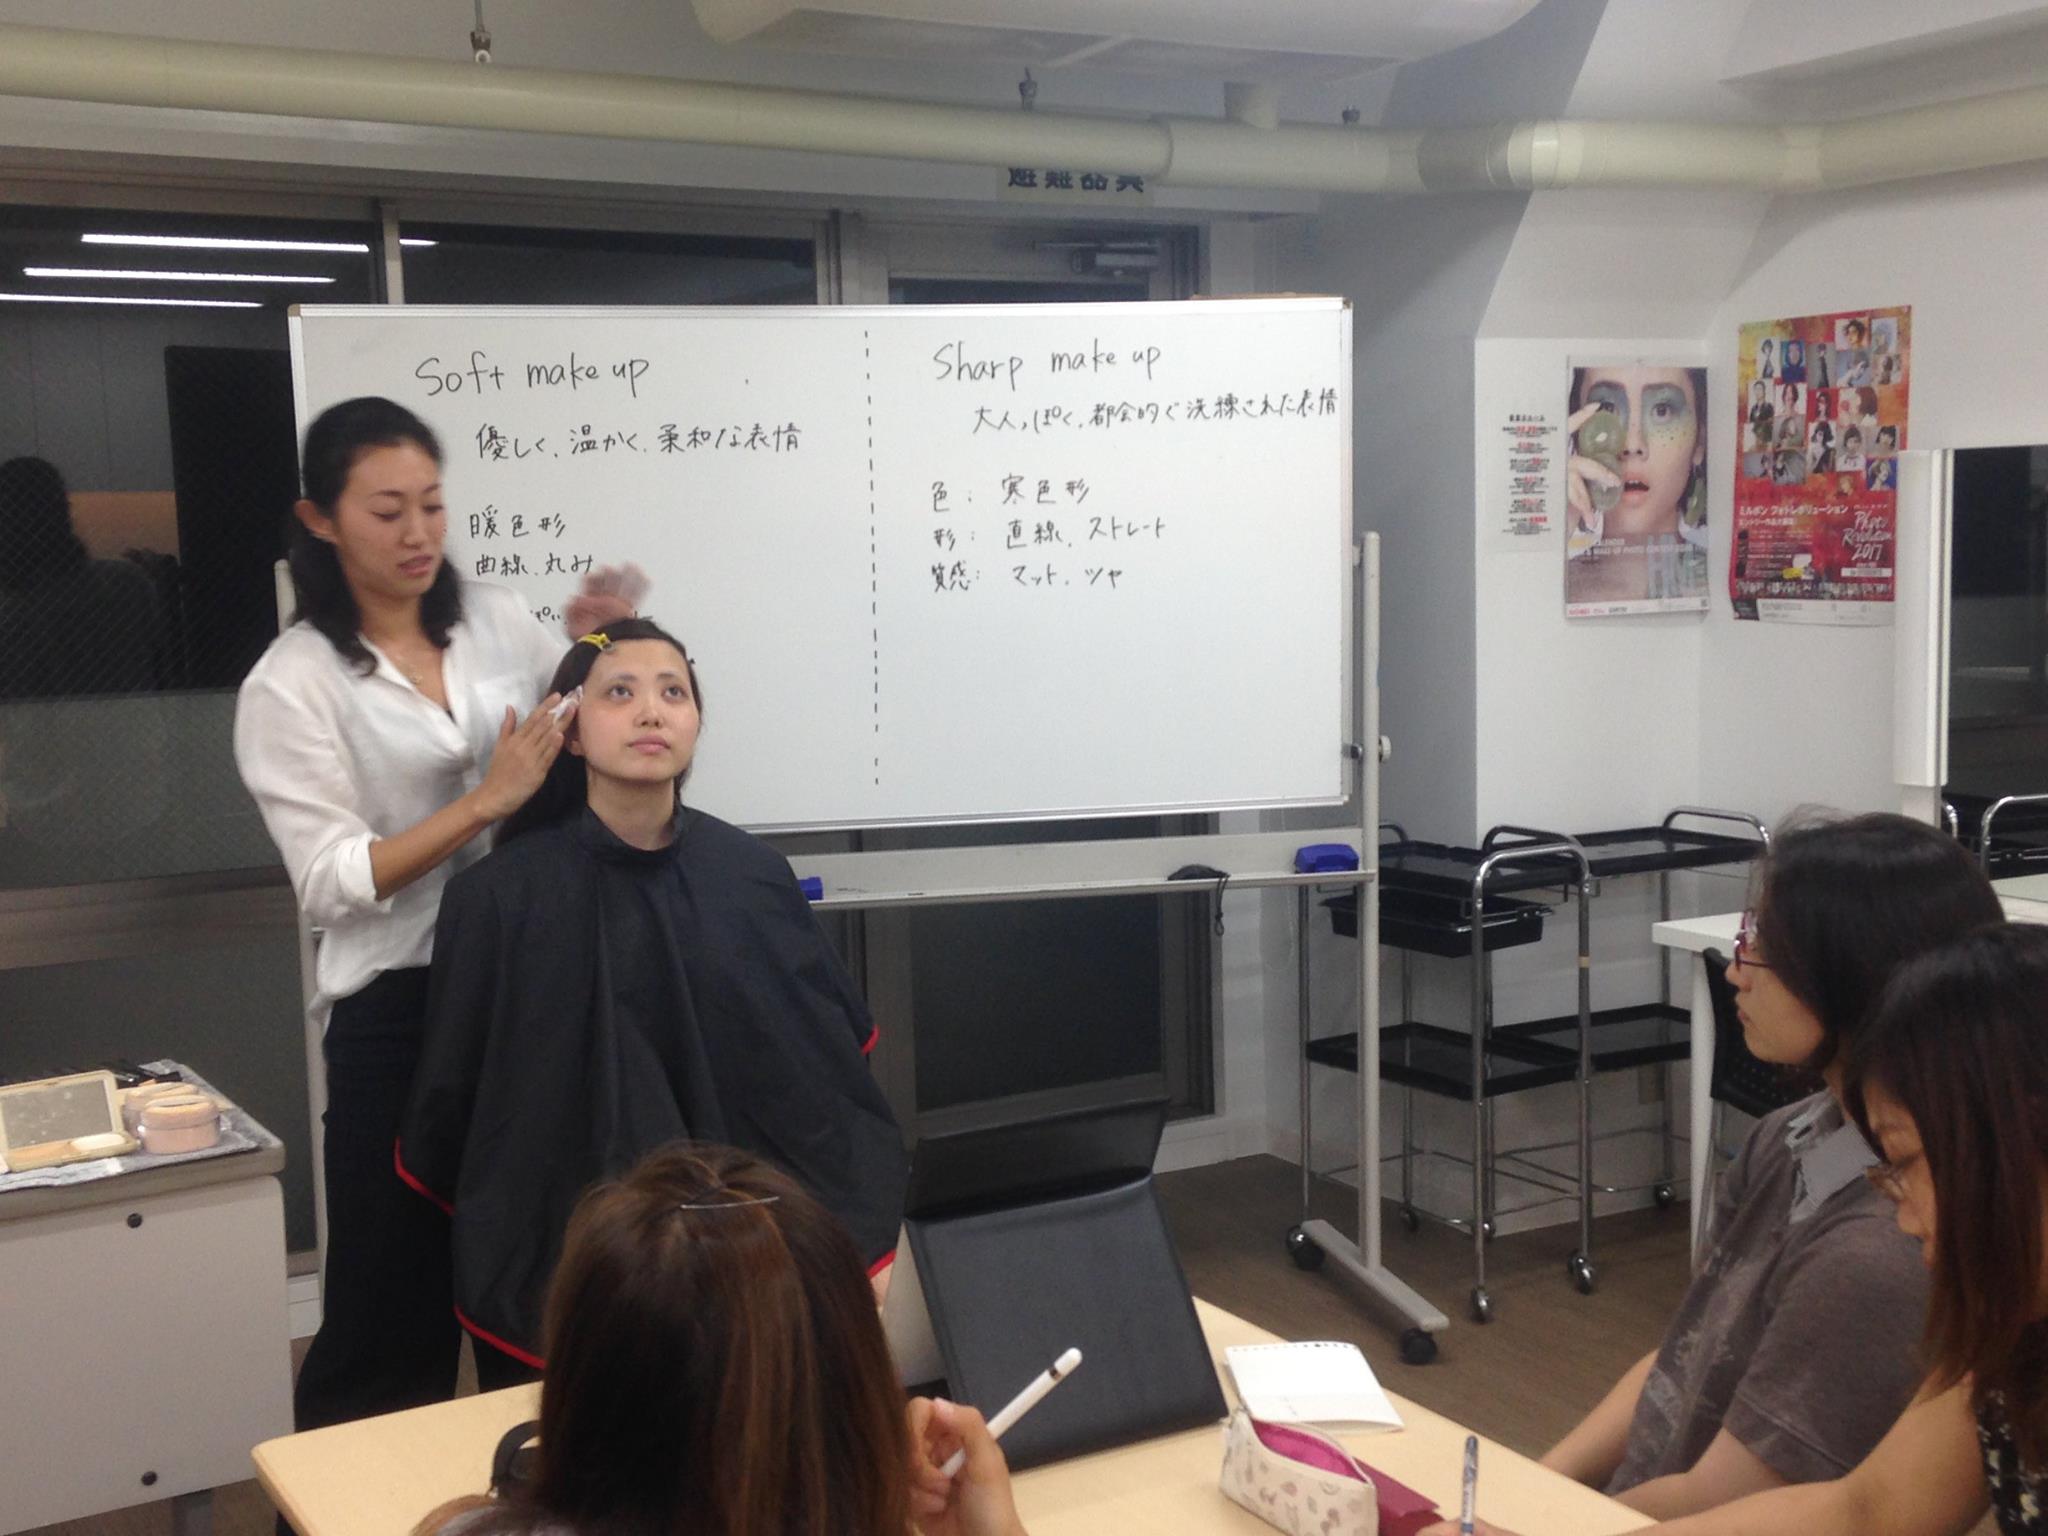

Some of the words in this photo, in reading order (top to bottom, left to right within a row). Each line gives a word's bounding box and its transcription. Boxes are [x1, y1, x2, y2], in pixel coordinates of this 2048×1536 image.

[415, 351, 504, 396] Soft
[526, 352, 599, 390] make
[612, 359, 650, 398] up
[933, 341, 1023, 392] Sharp
[1051, 338, 1116, 373] make
[1132, 346, 1161, 380] up
[1851, 543, 1883, 561] 2017
